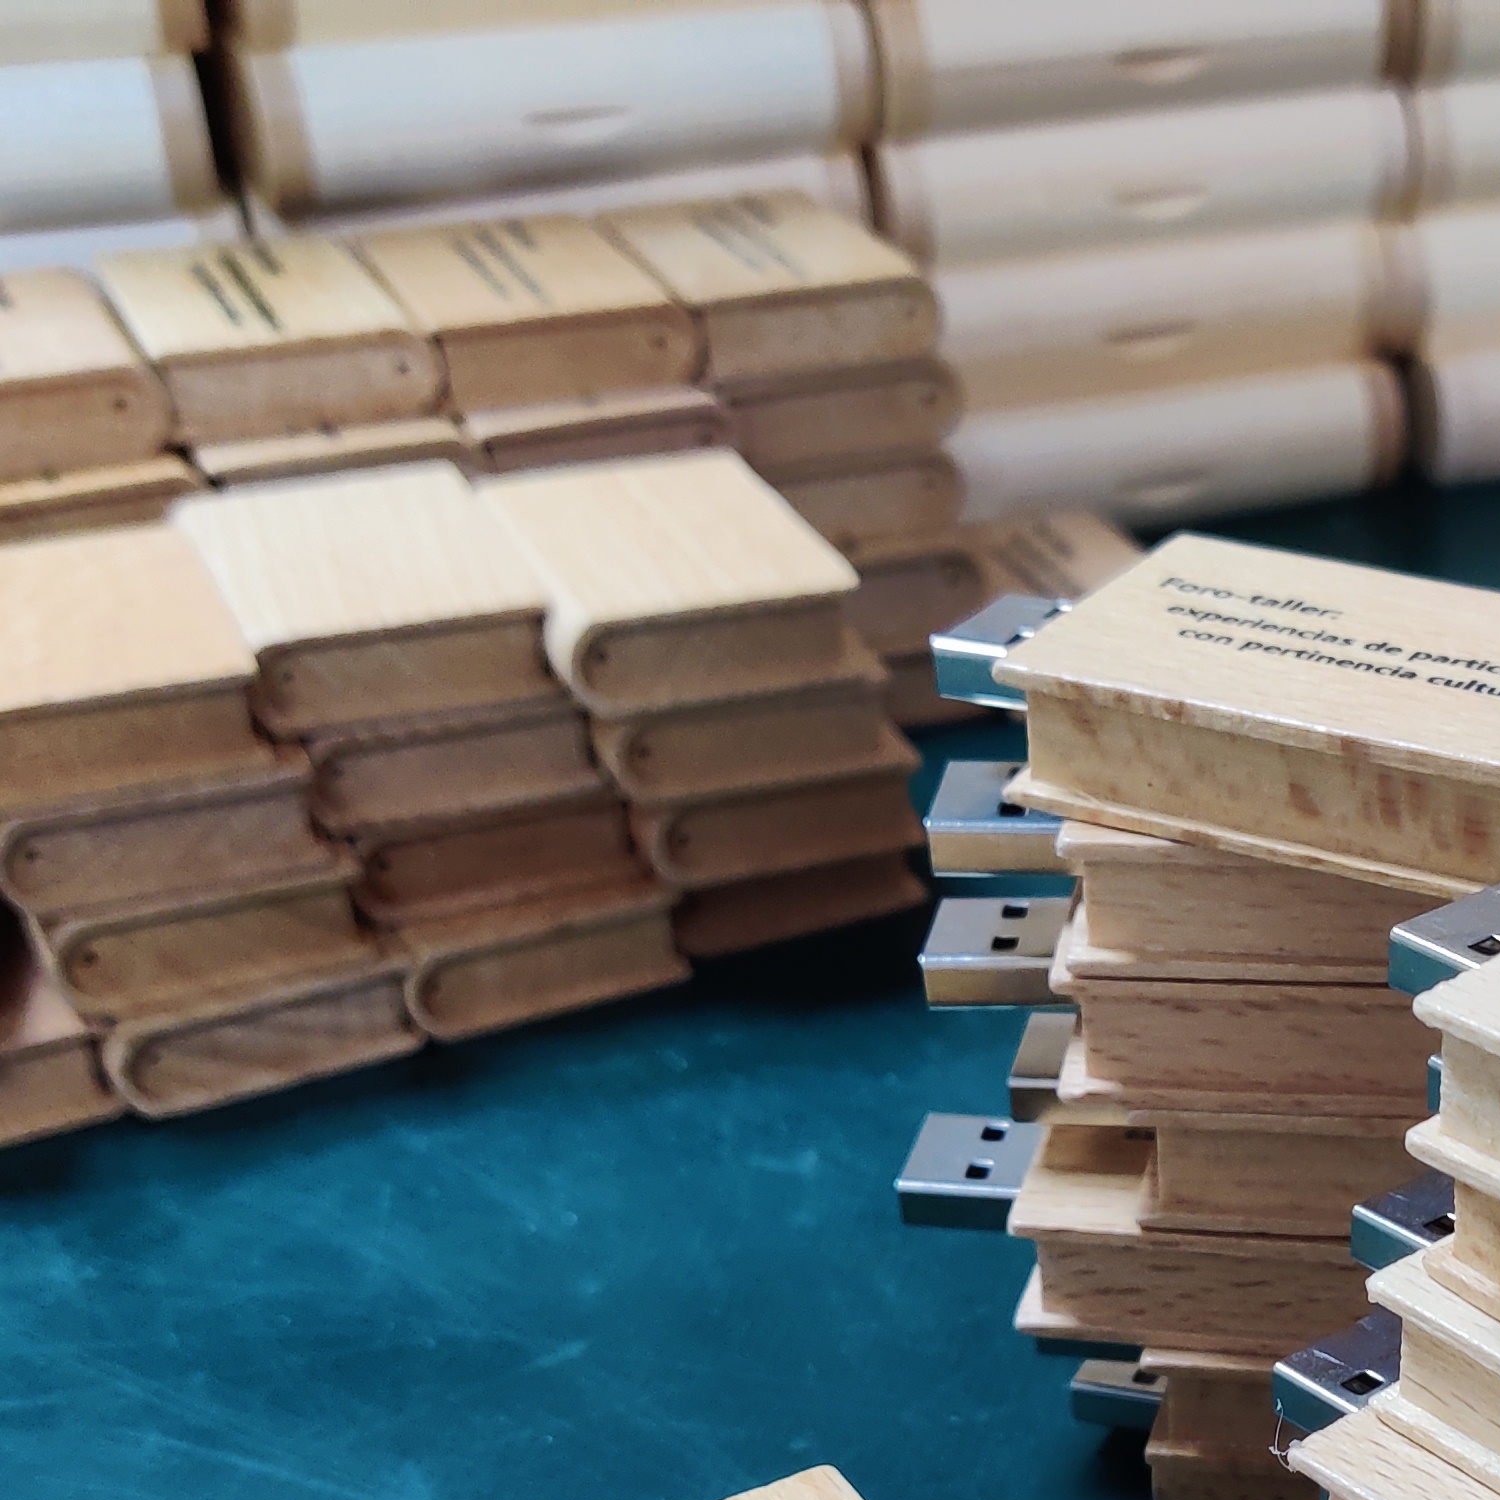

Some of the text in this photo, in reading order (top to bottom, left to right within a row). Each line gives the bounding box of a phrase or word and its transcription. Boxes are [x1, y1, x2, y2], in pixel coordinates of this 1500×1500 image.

[1166, 604, 1356, 647] experiencias
[1362, 641, 1404, 656] de
[1177, 628, 1235, 646] con
[1237, 639, 1419, 681] pertinencia
